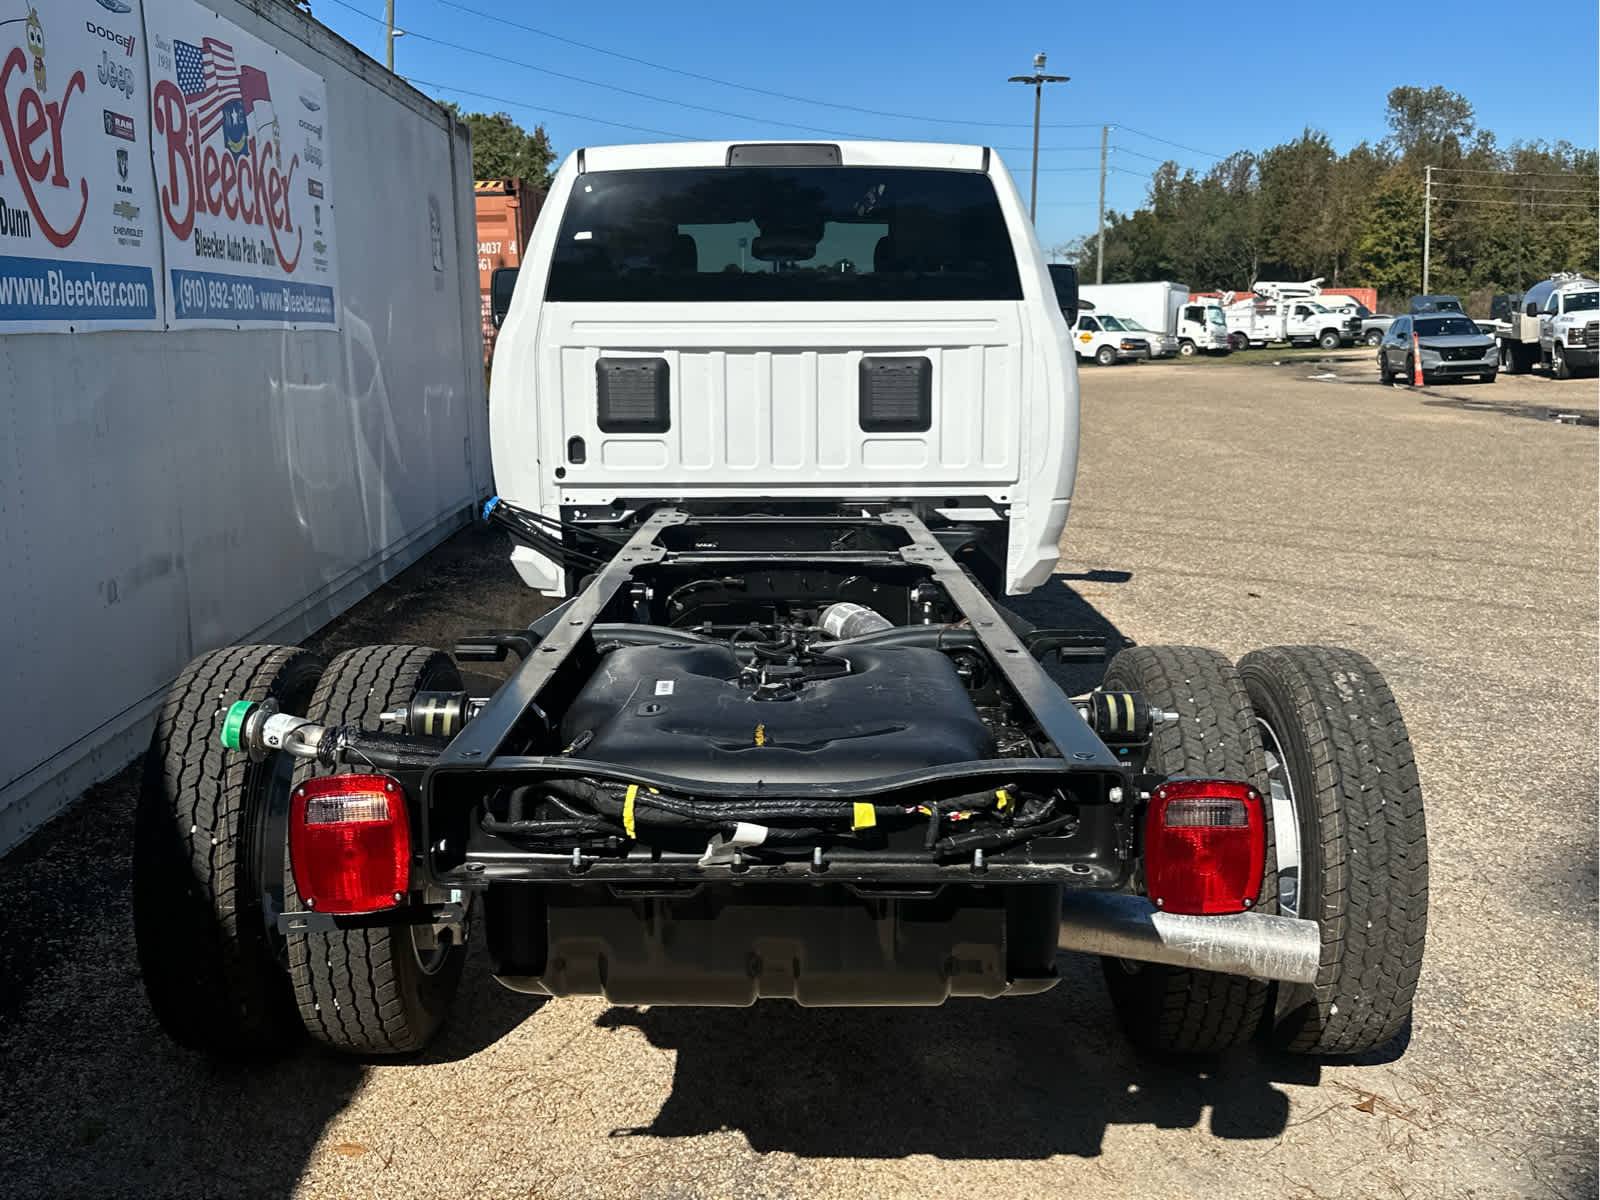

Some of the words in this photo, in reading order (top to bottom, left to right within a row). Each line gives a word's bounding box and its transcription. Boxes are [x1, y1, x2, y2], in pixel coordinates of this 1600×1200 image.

[86, 21, 132, 48] DODGE
[97, 49, 135, 99] Jeep
[114, 118, 132, 130] RAM
[154, 79, 302, 274] Bleecker
[194, 227, 226, 261] Bleecker
[226, 233, 242, 263] Auto
[242, 236, 258, 265] Park
[0, 270, 148, 308] www.Bleecker.com
[180, 274, 208, 314] (910)
[208, 280, 255, 311] 892-1800
